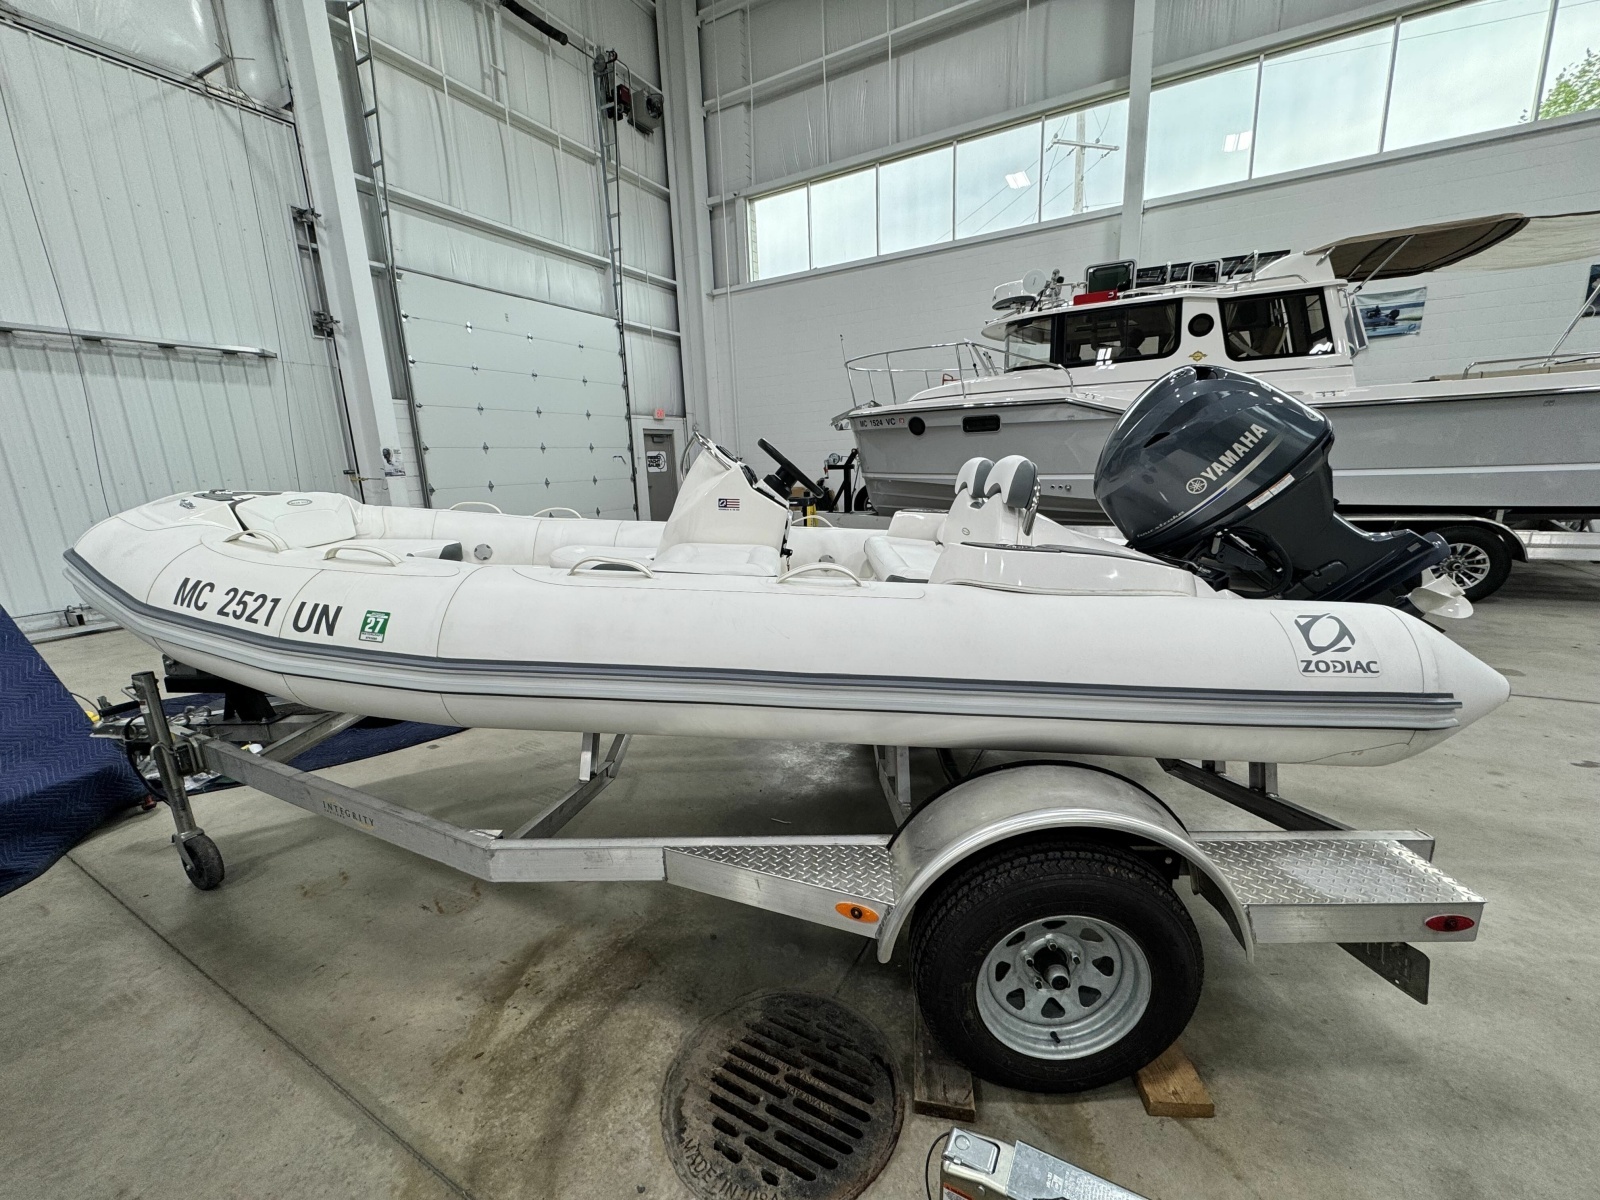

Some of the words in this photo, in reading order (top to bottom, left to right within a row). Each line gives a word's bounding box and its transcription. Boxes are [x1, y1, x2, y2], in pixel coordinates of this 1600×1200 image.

[870, 419, 883, 427] 1524
[885, 417, 896, 425] VC
[1201, 423, 1268, 481] YAMAHA
[173, 577, 215, 611] MC
[217, 587, 282, 627] 2521
[292, 601, 343, 636] UN
[364, 617, 385, 633] 27
[1300, 659, 1379, 673] ZODIAC
[322, 800, 374, 826] INTEGRITY
[683, 1138, 717, 1183] MADE
[719, 1179, 739, 1199] IN
